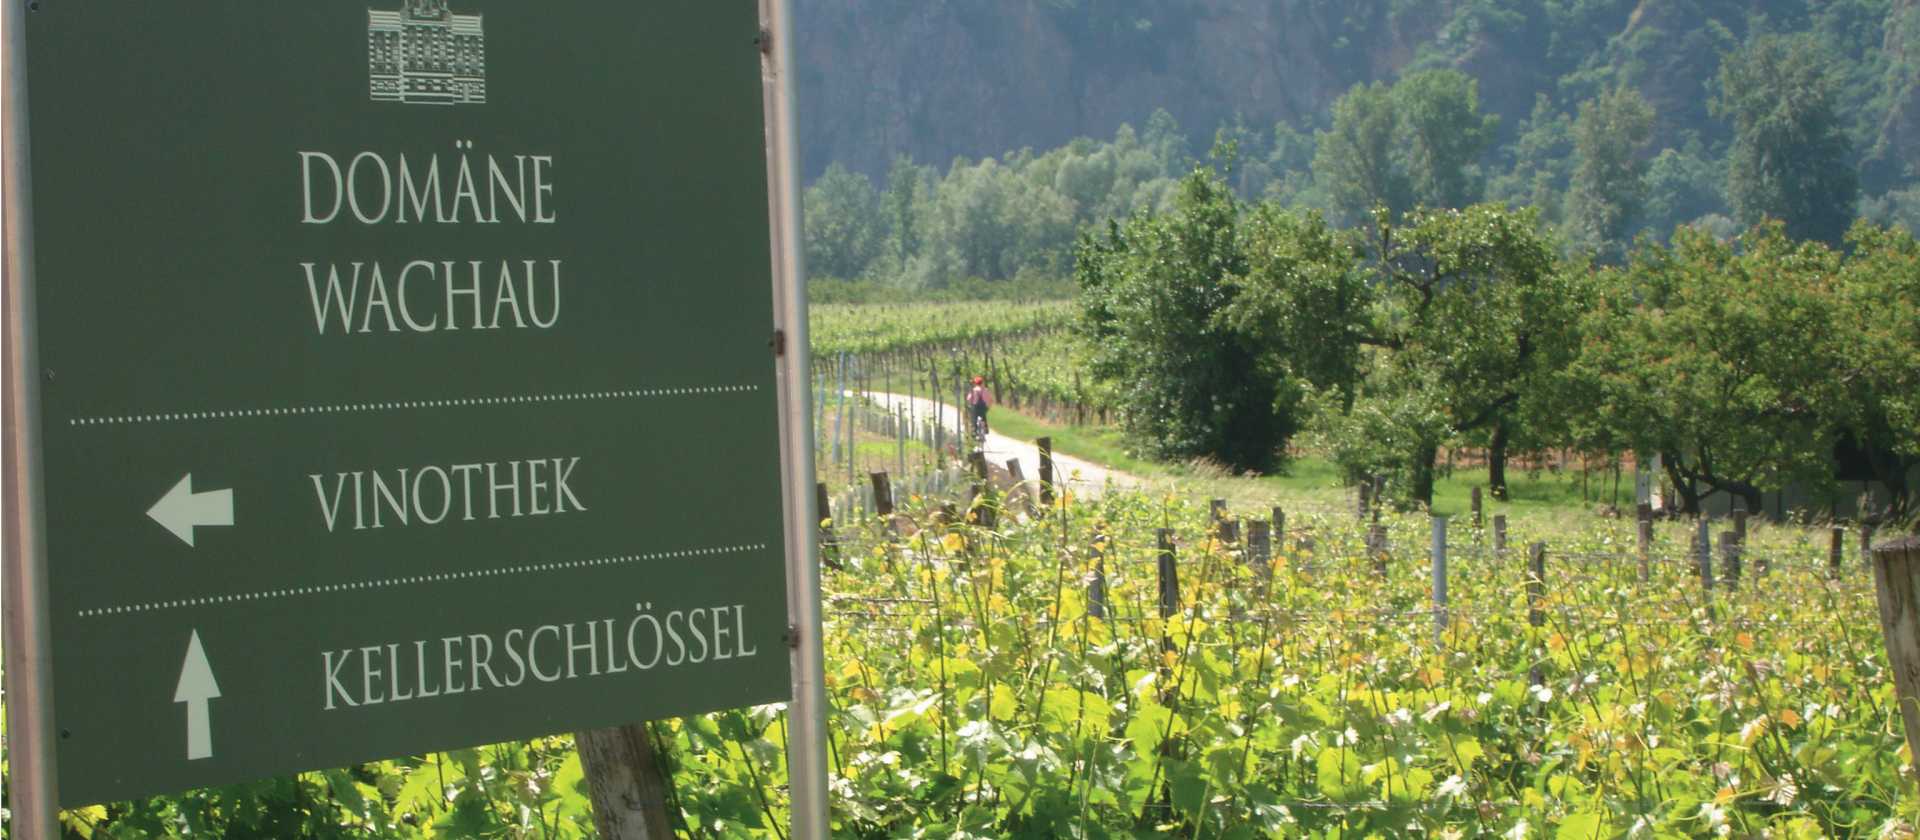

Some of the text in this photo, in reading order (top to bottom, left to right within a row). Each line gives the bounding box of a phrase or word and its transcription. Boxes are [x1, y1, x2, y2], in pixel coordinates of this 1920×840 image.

[299, 139, 556, 225] DOMÄNE
[301, 259, 562, 334] WACHAU
[309, 456, 588, 532] VINOTHEK
[322, 603, 757, 711] KELLERSCHLÖSSEL
